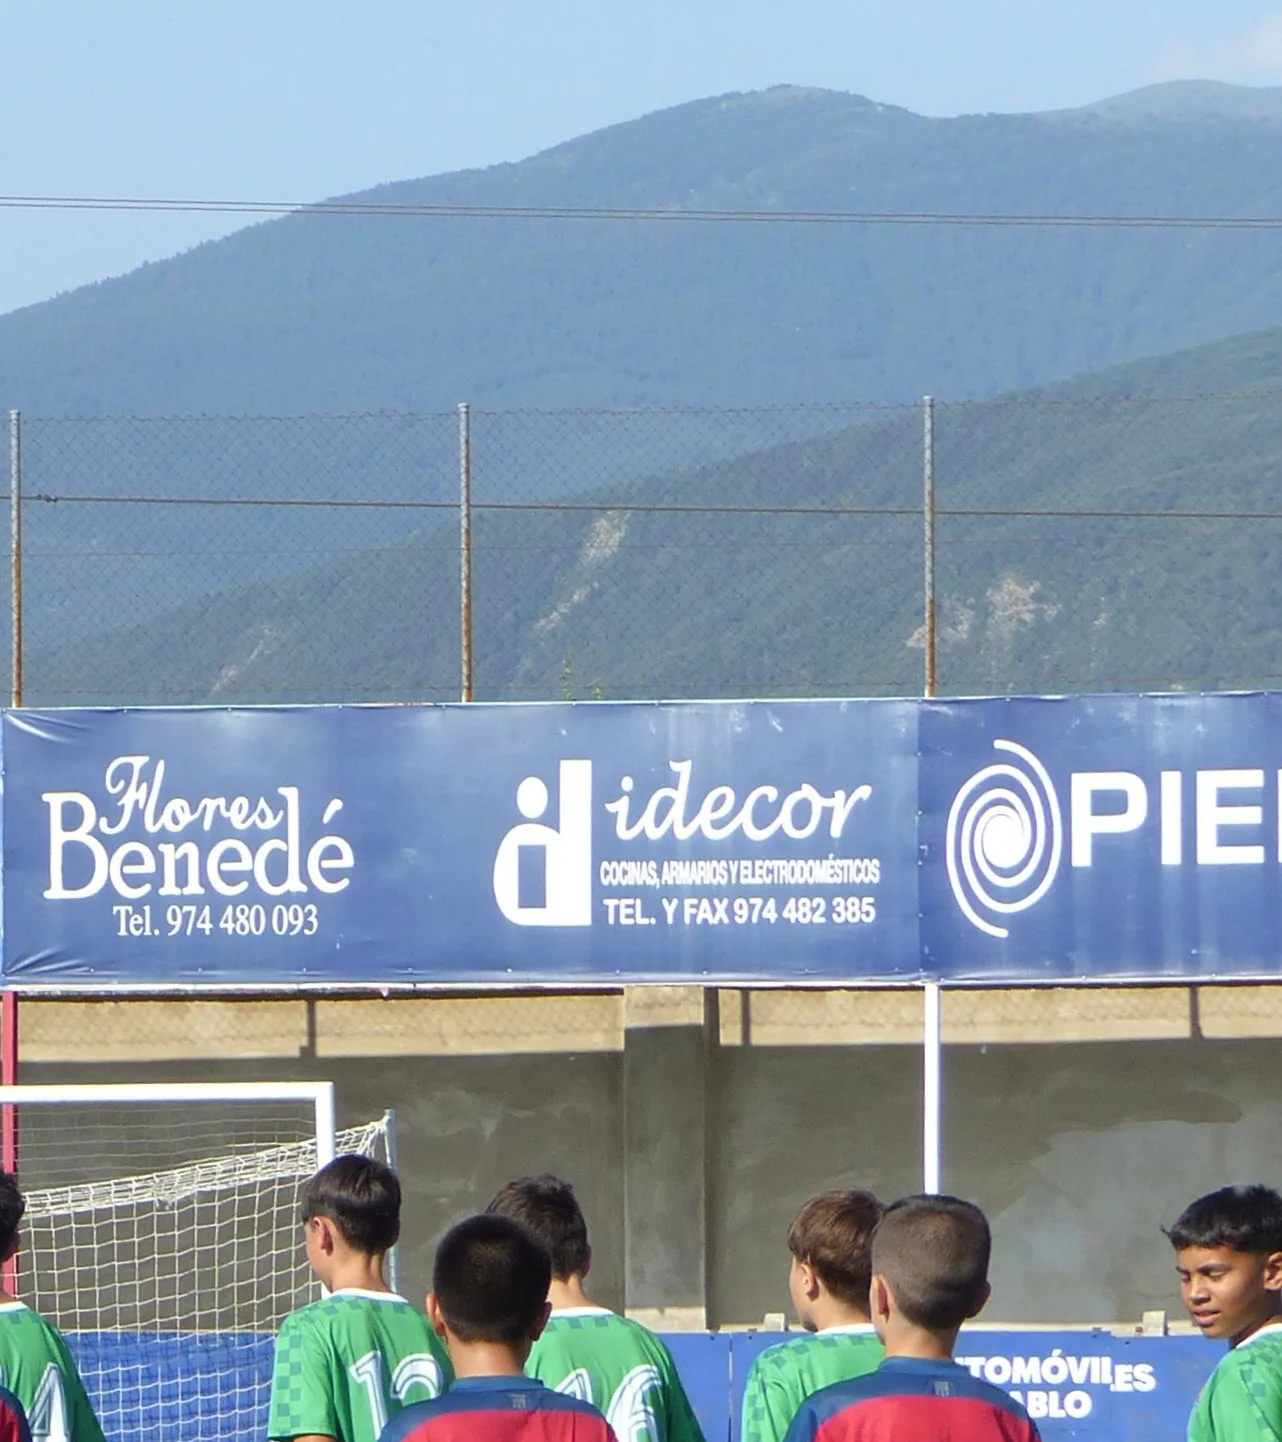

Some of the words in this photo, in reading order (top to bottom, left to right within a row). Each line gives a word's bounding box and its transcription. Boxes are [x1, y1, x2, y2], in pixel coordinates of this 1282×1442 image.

[96, 753, 285, 836] Flores
[604, 759, 872, 841] idecor
[1069, 768, 1282, 869] PIE
[40, 784, 357, 901] Benedé
[599, 857, 661, 888] COCINAS,
[662, 858, 728, 885] ARMARIOS
[728, 860, 739, 884] Y
[740, 853, 880, 885] ELECTRODOMÉSTICOS
[112, 905, 160, 936] Tel.
[166, 904, 214, 936] 974
[219, 904, 266, 936] 480
[271, 904, 318, 936] 093
[602, 898, 656, 925] TEL.
[661, 897, 679, 925] Y
[683, 897, 730, 925] FAX
[733, 897, 778, 924] 974
[782, 897, 826, 924] 482
[831, 896, 876, 924] 385
